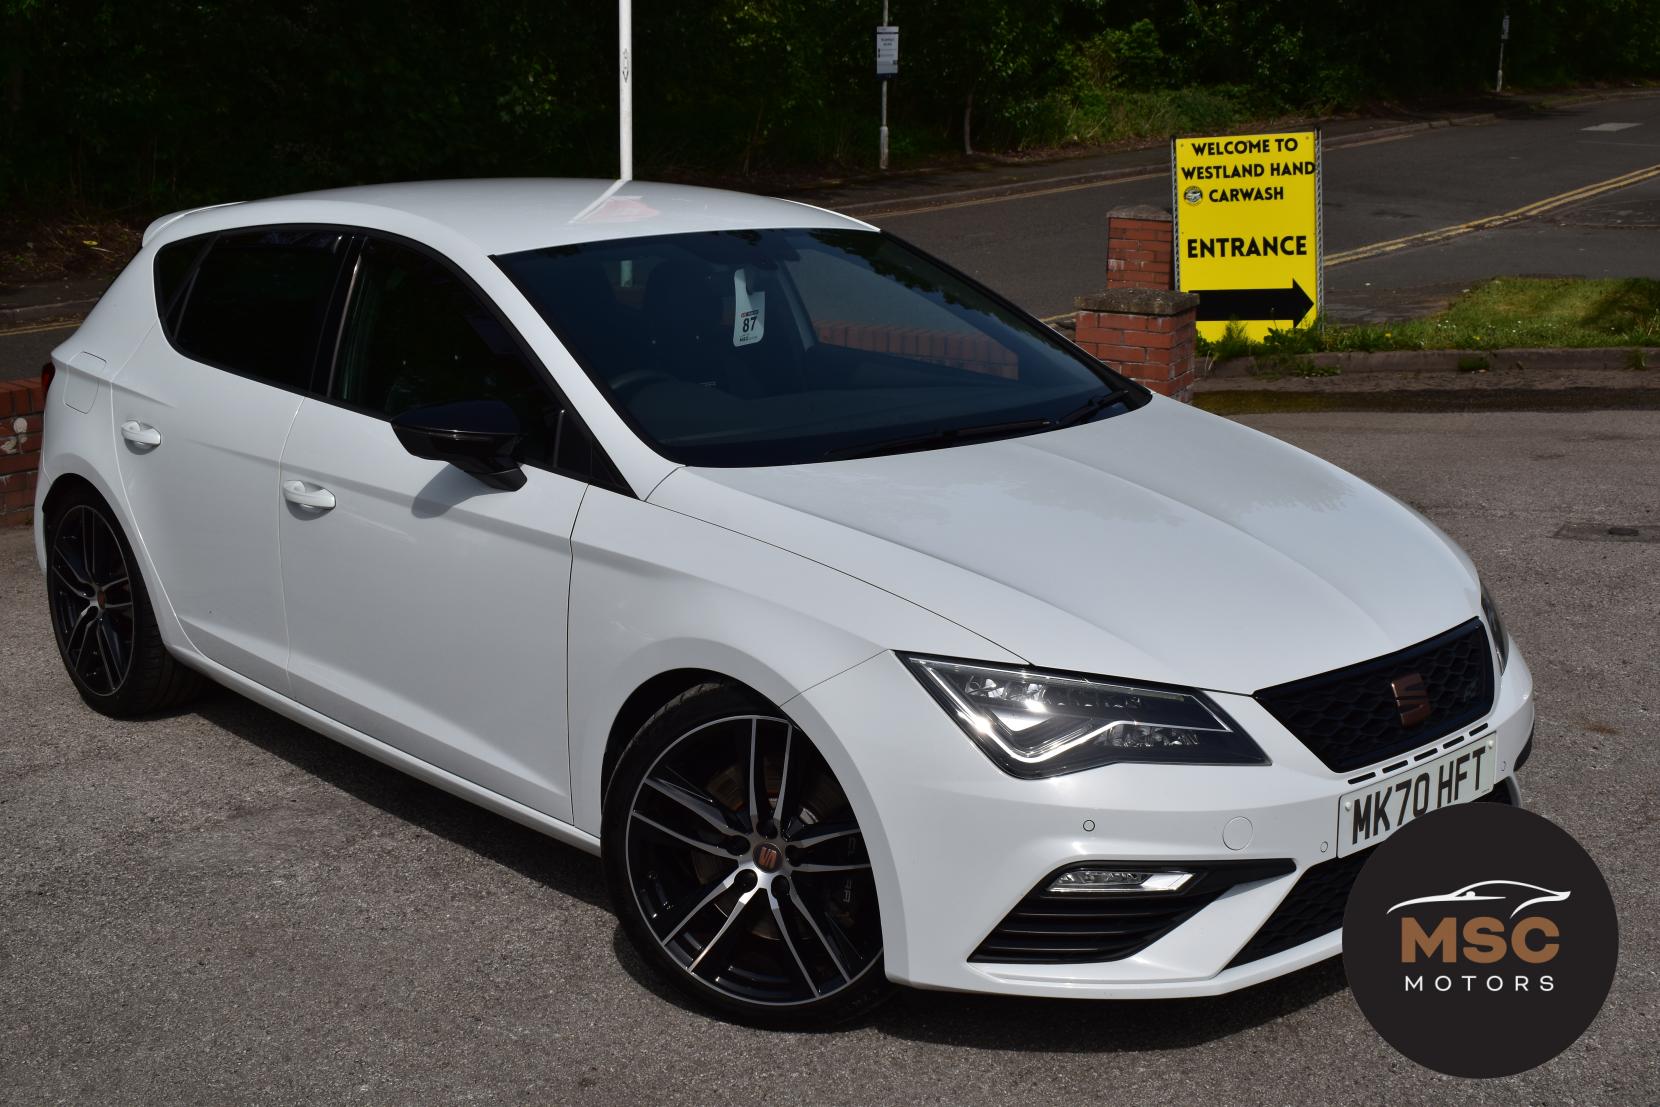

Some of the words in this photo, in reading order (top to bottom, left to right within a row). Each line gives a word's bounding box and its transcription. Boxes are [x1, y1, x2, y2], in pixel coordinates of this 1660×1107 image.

[1192, 140, 1270, 156] WELCOME
[1275, 138, 1298, 152] TO
[1181, 164, 1265, 180] WESTLAND
[1270, 161, 1316, 177] HAND
[1208, 187, 1284, 202] CARWASH
[1187, 236, 1307, 258] ENTRANCE
[743, 316, 757, 332] 87
[1352, 772, 1430, 845] MK70
[1437, 746, 1486, 808] HFT
